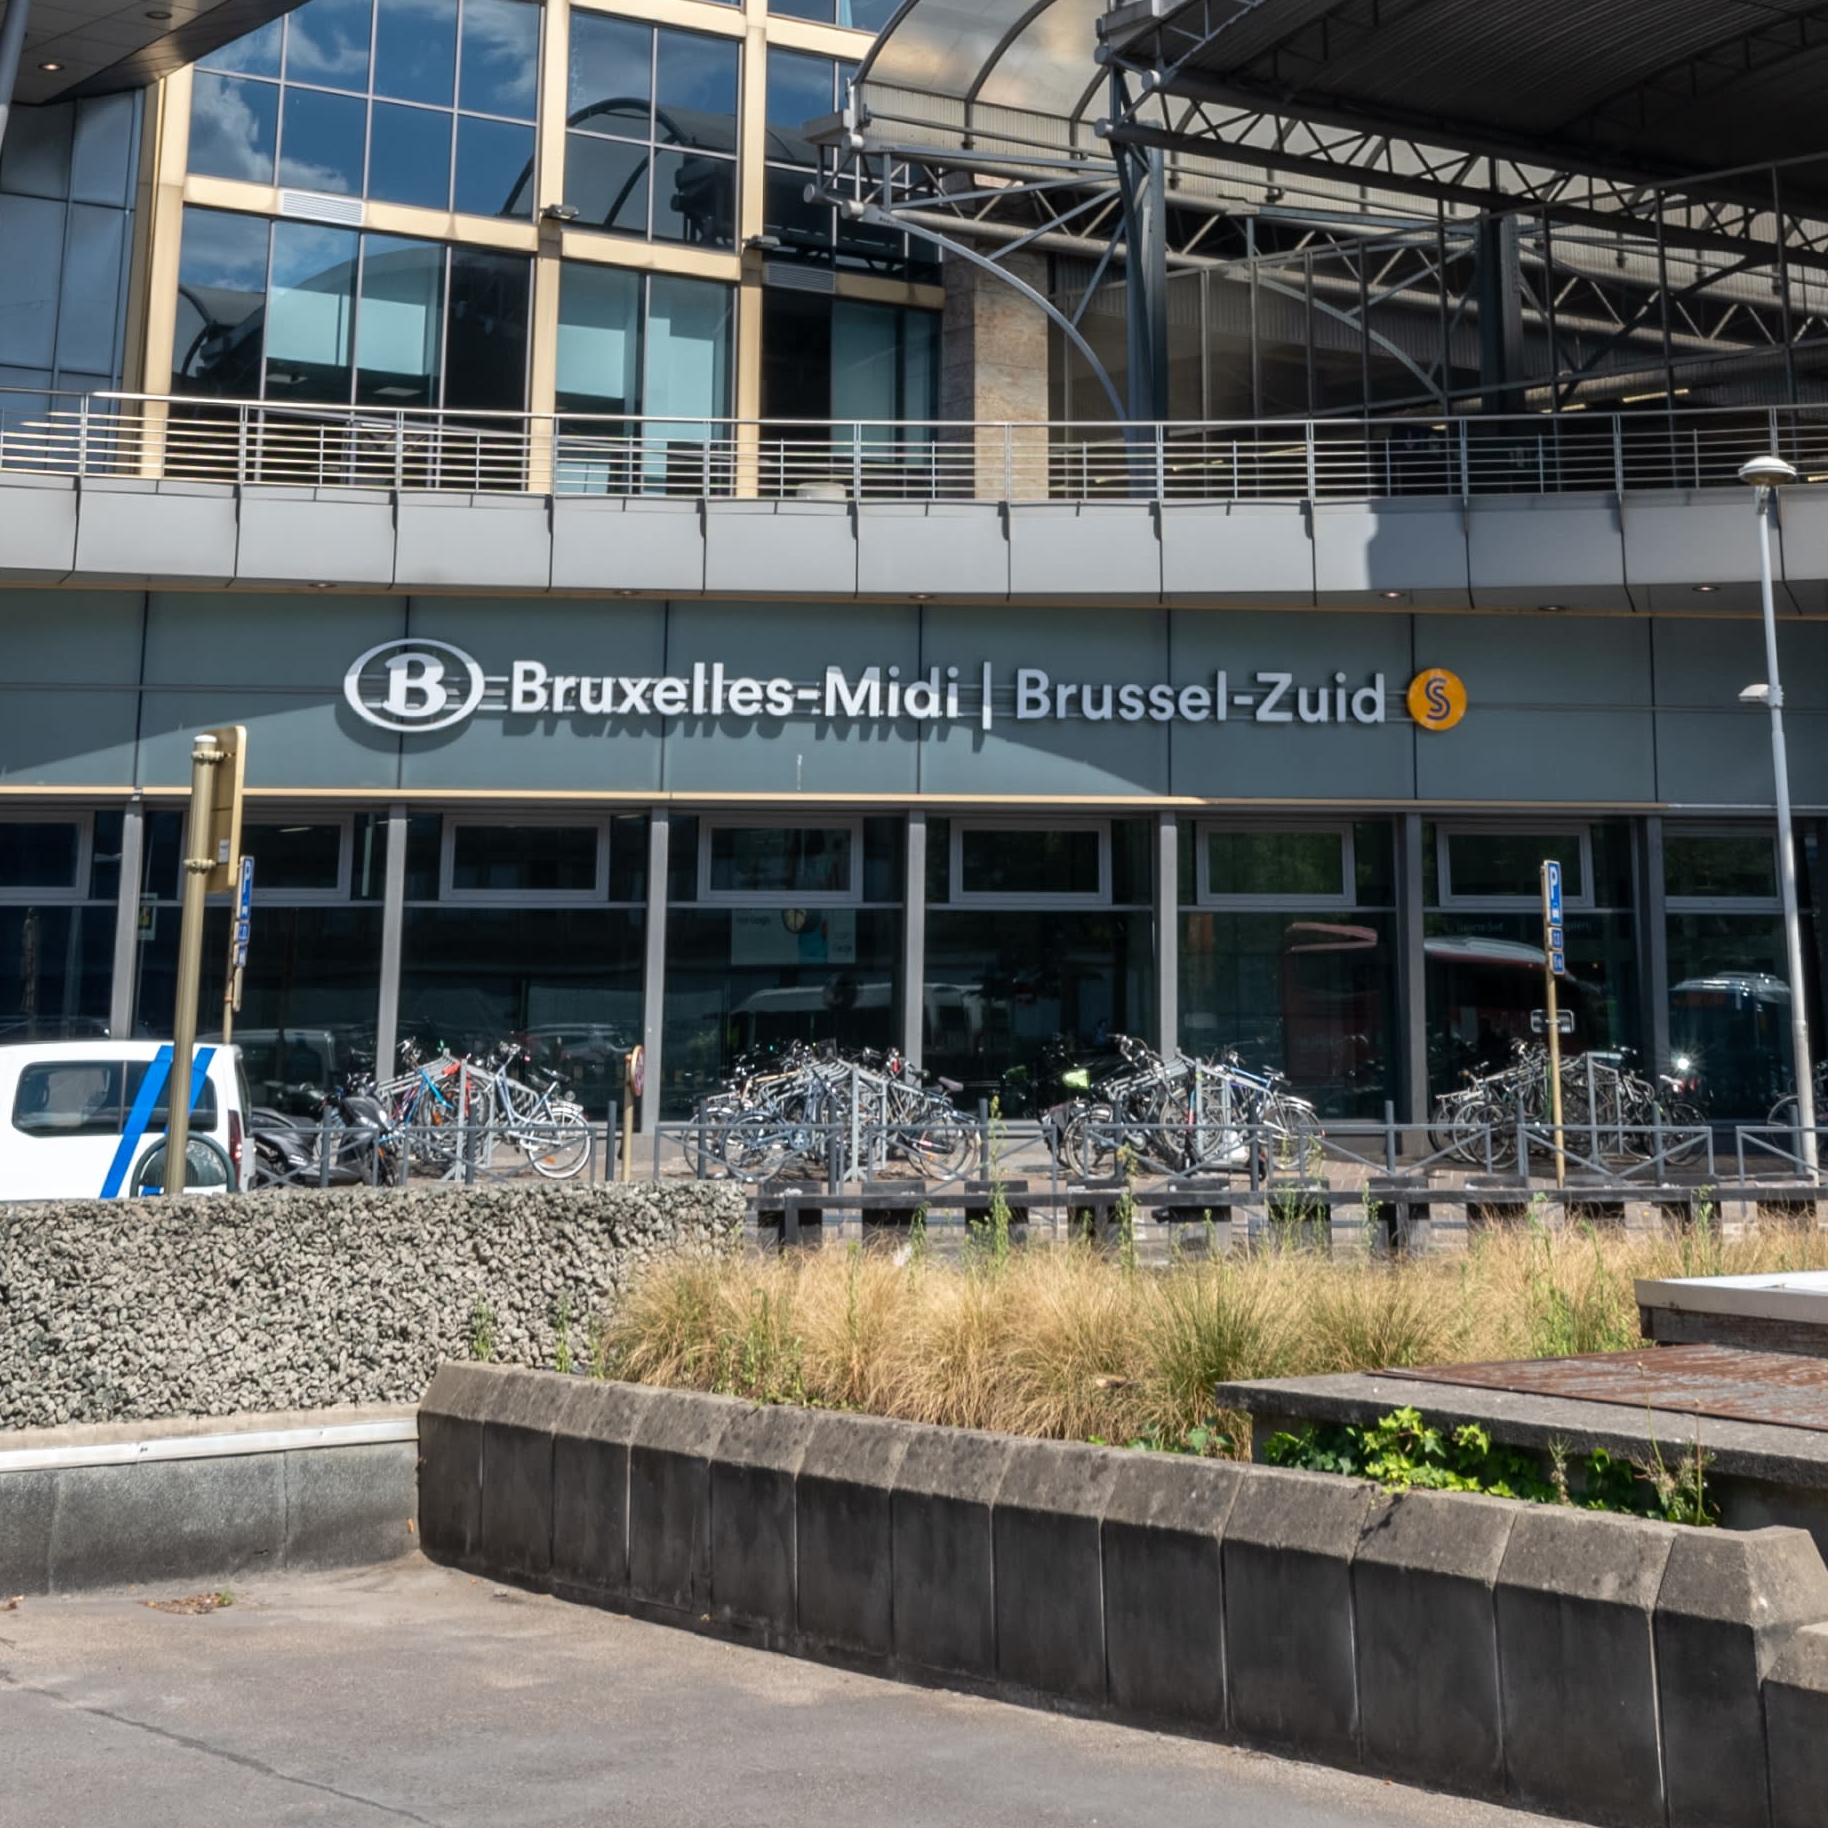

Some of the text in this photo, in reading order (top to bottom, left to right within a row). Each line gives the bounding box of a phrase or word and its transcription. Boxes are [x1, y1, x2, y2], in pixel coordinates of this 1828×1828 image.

[511, 660, 959, 719] Bruxelles-Midi
[1016, 668, 1385, 722] Brussel-Zuid
[1549, 866, 1558, 899] P
